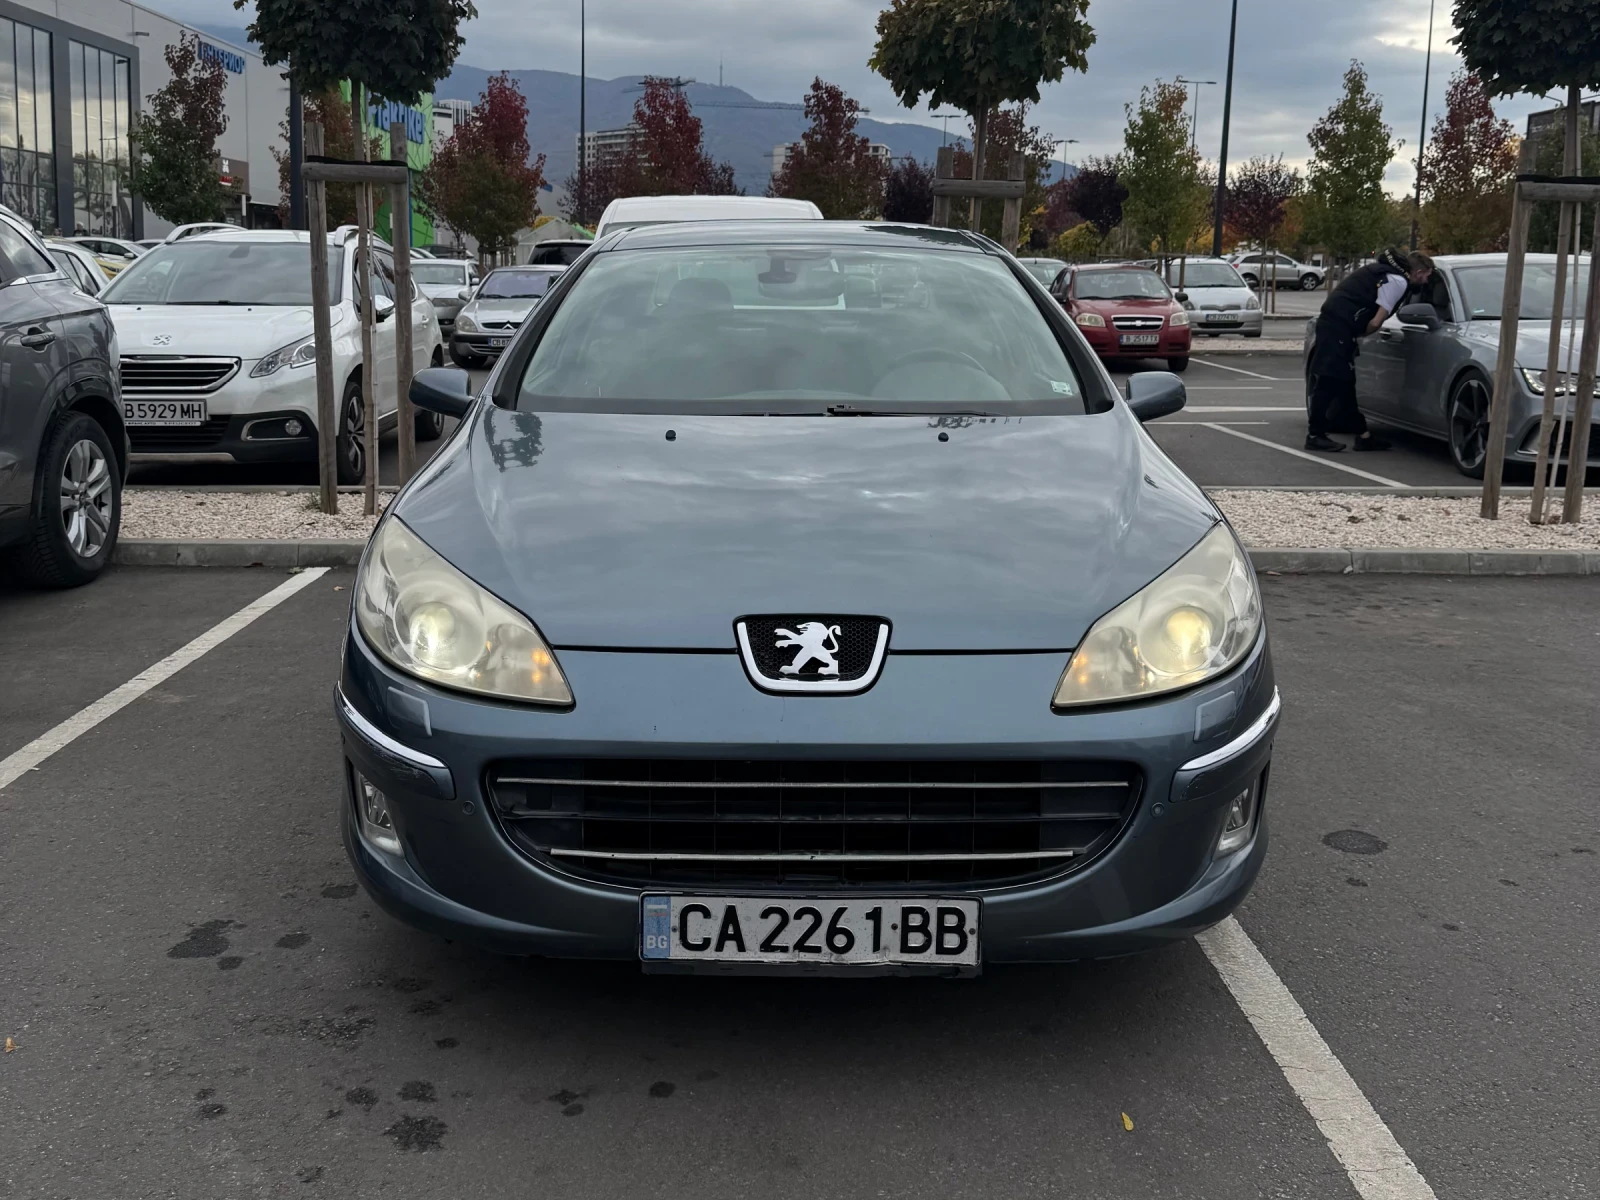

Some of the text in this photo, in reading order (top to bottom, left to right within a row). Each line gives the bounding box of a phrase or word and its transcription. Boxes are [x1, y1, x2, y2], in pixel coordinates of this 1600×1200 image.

[138, 403, 177, 419] 5929
[180, 403, 202, 419] MH
[679, 903, 968, 956] CA 2261 BB
[646, 935, 668, 950] BG
